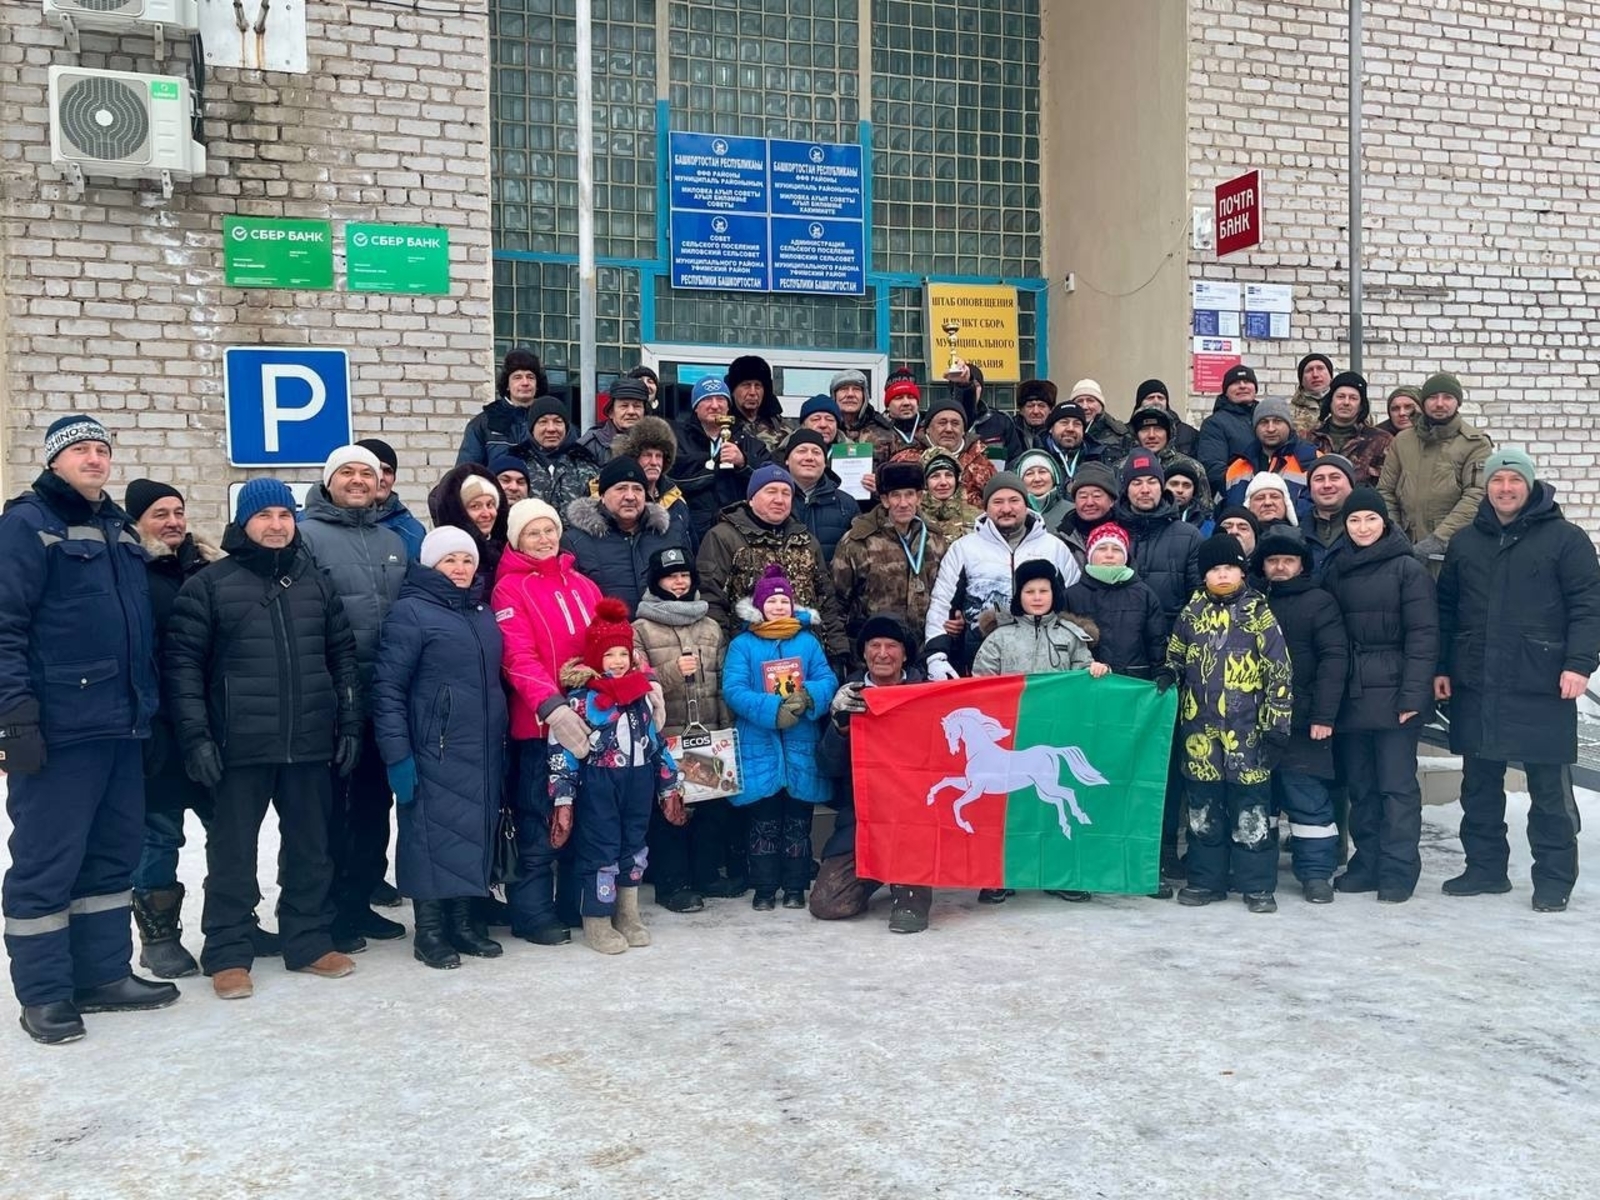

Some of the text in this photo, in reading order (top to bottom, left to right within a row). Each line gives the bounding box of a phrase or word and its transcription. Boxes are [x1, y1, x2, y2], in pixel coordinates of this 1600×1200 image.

[674, 175, 720, 184] МУНИЦИПАЛЬ
[712, 170, 741, 179] РАЙОНЫ
[811, 176, 837, 184] РАЙОНЫ
[774, 182, 818, 191] МУНИЦИПАЛЬ
[681, 187, 761, 198] МИЛОВКА АУЫЛ СОВЕТЫ
[779, 193, 810, 201] МИЛОВКА
[829, 196, 856, 204] СОВЕТЫ
[1219, 188, 1254, 218] ПОЧТА
[1219, 212, 1250, 240] БАНК
[250, 229, 324, 242] СБЕР БАНК
[709, 234, 731, 242] СОВЕТ
[371, 235, 441, 248] СБЕР БАНК
[681, 240, 760, 251] СЕЛЬСКОГО ПОСЕЛЕНИЯ
[790, 239, 846, 248] АДМИНИСТРАЦИЯ
[681, 248, 760, 258] МИЛОВСКИЙ СЕЛЬСОВЕТ
[779, 245, 855, 255] СЕЛЬСКОГО ПОСЕЛЕНИЯ
[675, 258, 738, 267] МУНИЦИПАЛЬНОГО
[779, 253, 855, 263] МИЛОВСКИЙ СЕЛЬСОВЕТ
[728, 266, 751, 274] РАЙОН
[774, 262, 860, 272] МУНИЦИПАЛЬНОГО РАЙОНА
[790, 269, 825, 277] УФИМСКИЙ
[680, 274, 762, 288] РЕСПУБЛИКИ БАШКОРТОСТАН
[779, 278, 858, 292] РЕСПУБЛИКИ БАШКОРТОСТАН
[932, 297, 1014, 308] ШТАБ ОПОВЕЩЕНИЯ
[980, 319, 1005, 328] СБОРА
[936, 338, 1015, 349] МУИЦИПАЛЬНОГО
[683, 736, 711, 748] ECOS
